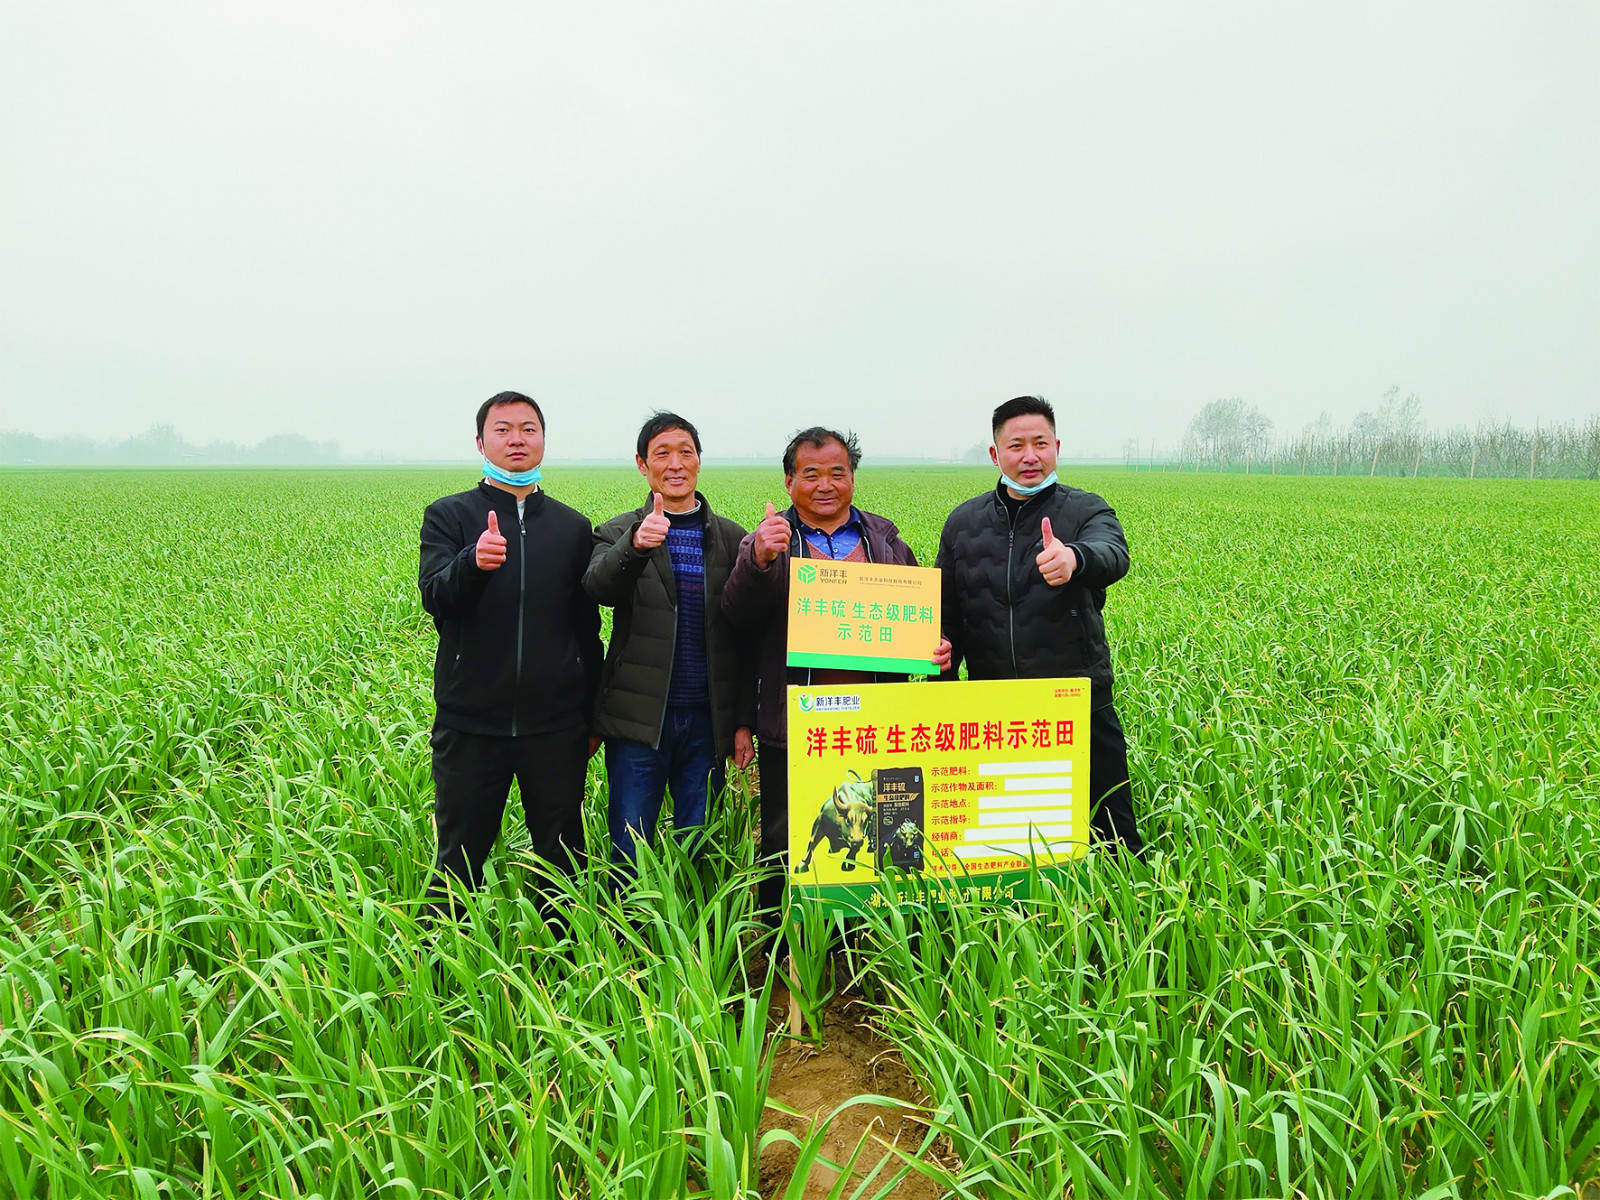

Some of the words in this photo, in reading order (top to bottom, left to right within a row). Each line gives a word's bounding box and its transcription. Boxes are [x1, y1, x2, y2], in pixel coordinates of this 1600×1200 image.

[820, 567, 848, 578] 新洋丰
[838, 623, 893, 642] 示范田
[816, 695, 860, 706] 新洋丰肥业
